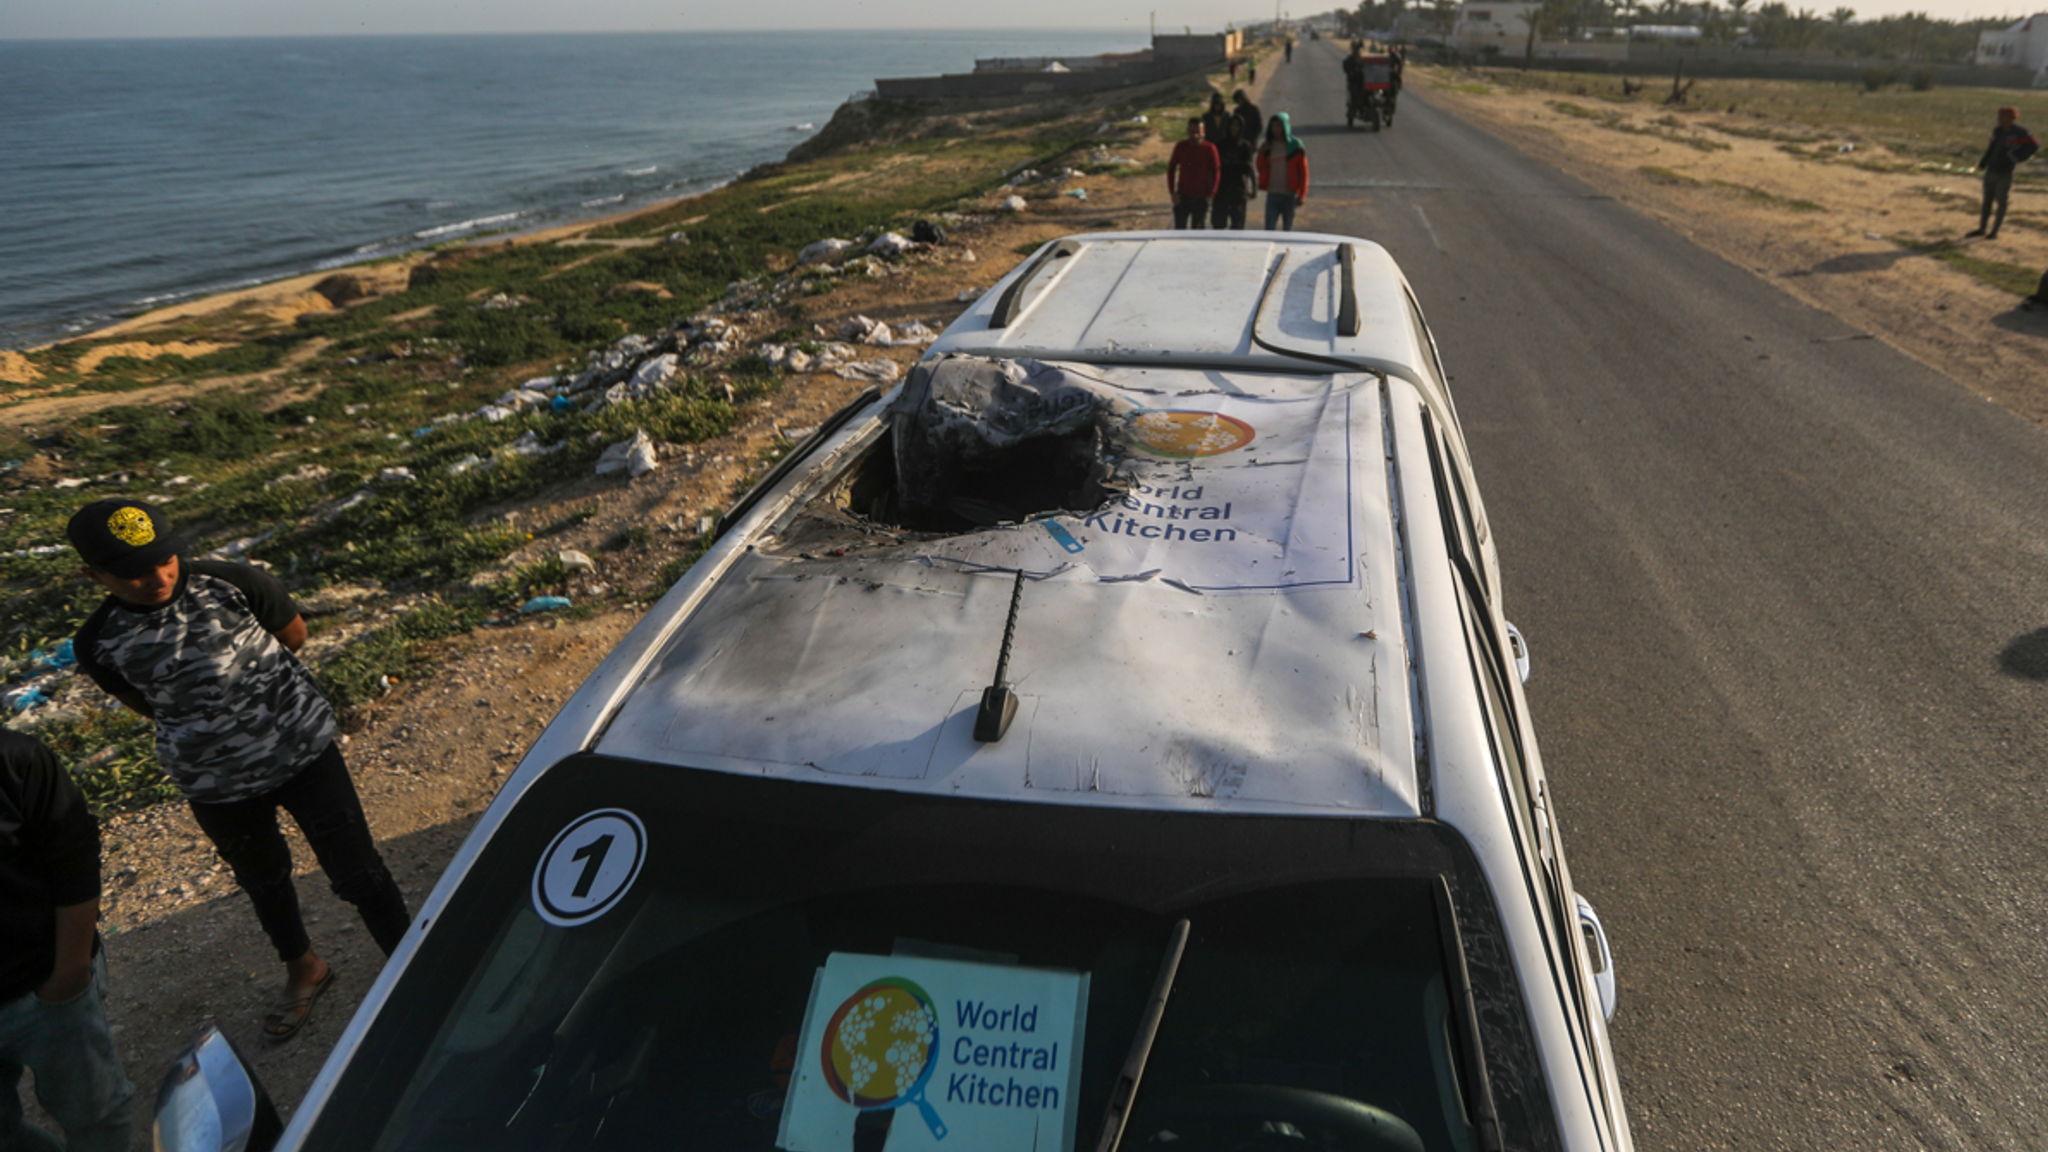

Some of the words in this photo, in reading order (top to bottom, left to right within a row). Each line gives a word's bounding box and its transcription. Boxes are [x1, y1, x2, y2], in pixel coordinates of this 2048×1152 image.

[1109, 494, 1232, 520] entral
[1137, 484, 1204, 500] orld
[1084, 510, 1237, 542] Kitchen
[571, 834, 616, 899] 1
[956, 1000, 1038, 1032] World
[952, 1036, 1058, 1071] Central
[947, 1073, 1059, 1109] Kitchen
